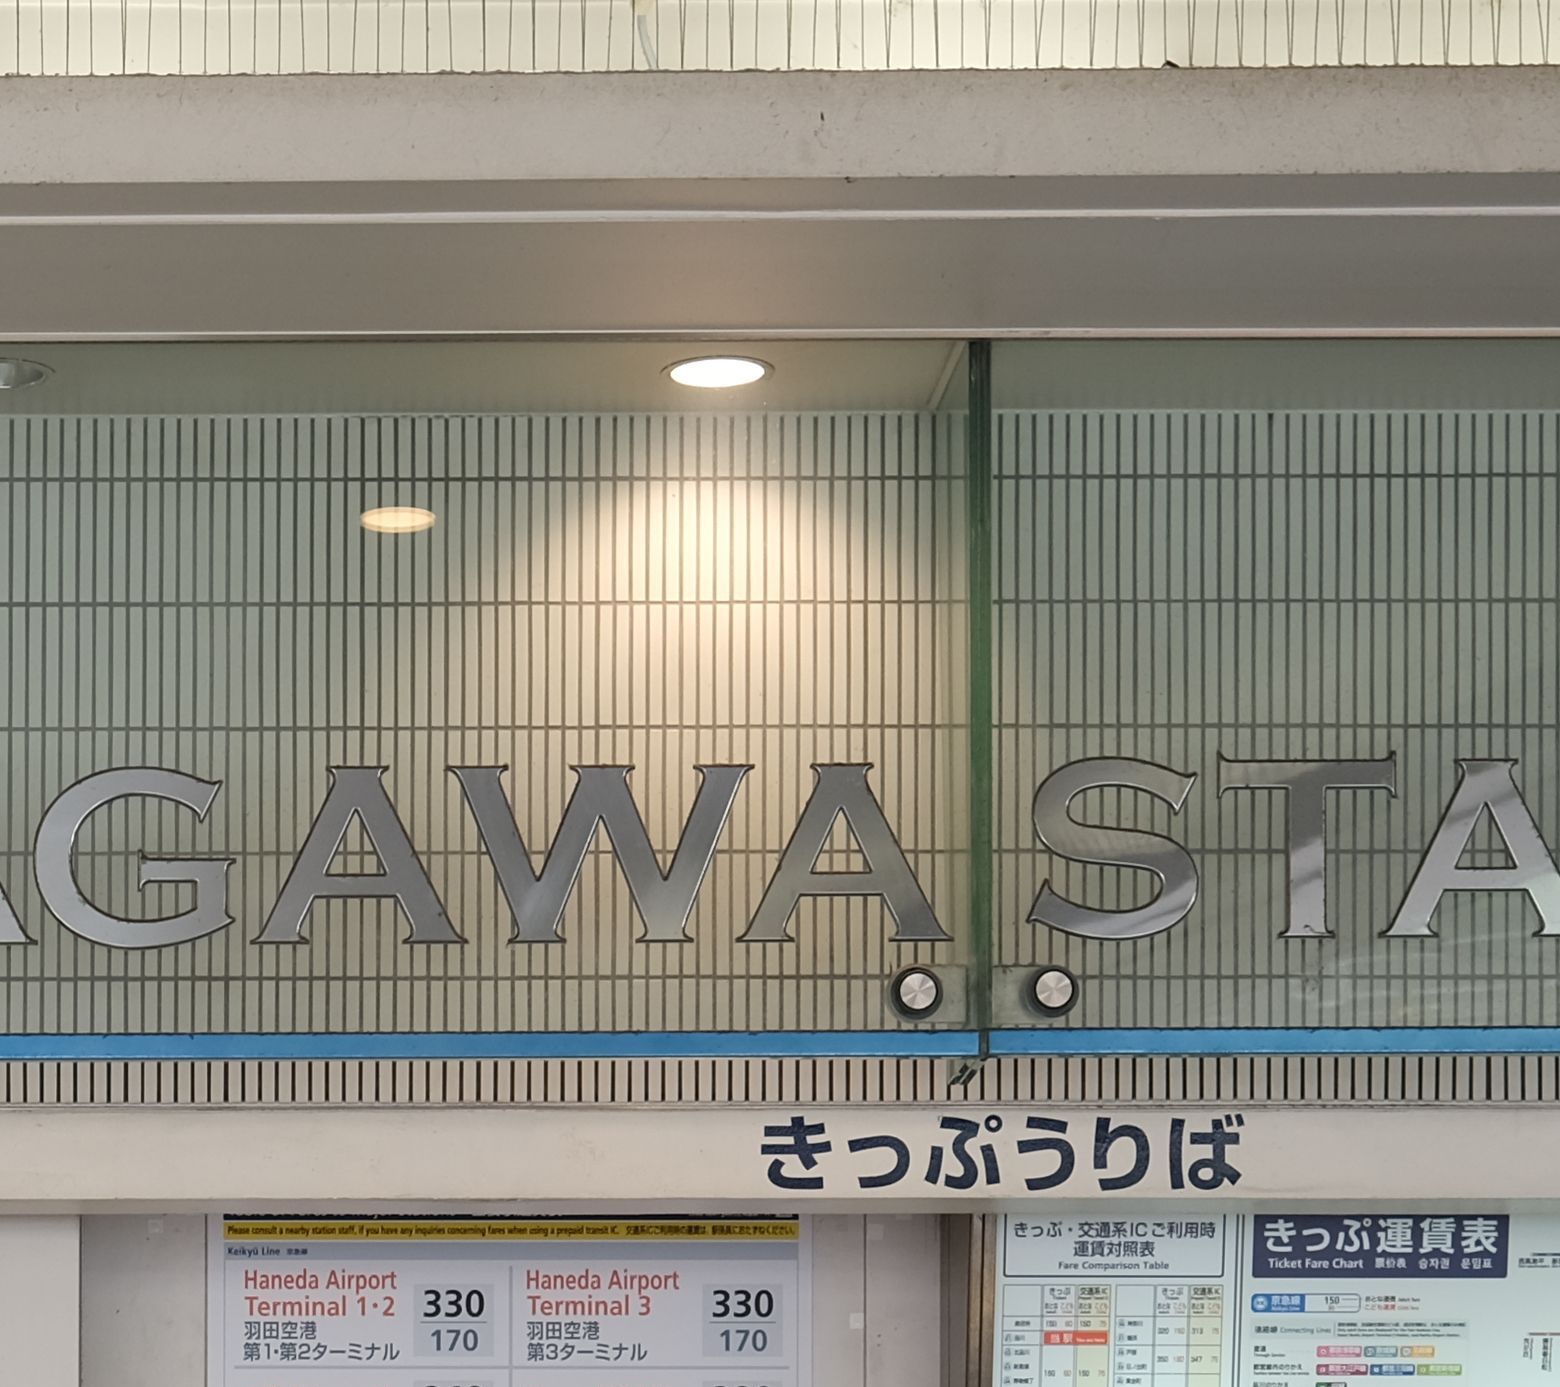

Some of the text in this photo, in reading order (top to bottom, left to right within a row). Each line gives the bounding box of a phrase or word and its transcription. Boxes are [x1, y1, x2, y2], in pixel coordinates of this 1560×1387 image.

[757, 1114, 1245, 1196] きっぷうりば
[1263, 1217, 1499, 1255] きっぷ運賃表
[1073, 1240, 1155, 1258] 運賃対照表
[1058, 1261, 1169, 1273] Fare Comparison Table
[1268, 1258, 1363, 1269] Ticket Fare Chart
[244, 1269, 397, 1294] Haneda Airport
[526, 1269, 679, 1294] Haneda Airport
[245, 1296, 347, 1316] Terminal
[422, 1289, 484, 1318] 330
[527, 1296, 651, 1316] Terminal 3
[712, 1289, 773, 1318] 330
[243, 1321, 317, 1340] 羽田空港
[526, 1321, 600, 1340] 羽田空港
[430, 1330, 478, 1352] 170
[719, 1330, 767, 1352] 170
[243, 1342, 399, 1361] 第1・第2ターミナル
[526, 1342, 647, 1362] 第3ターミナル
